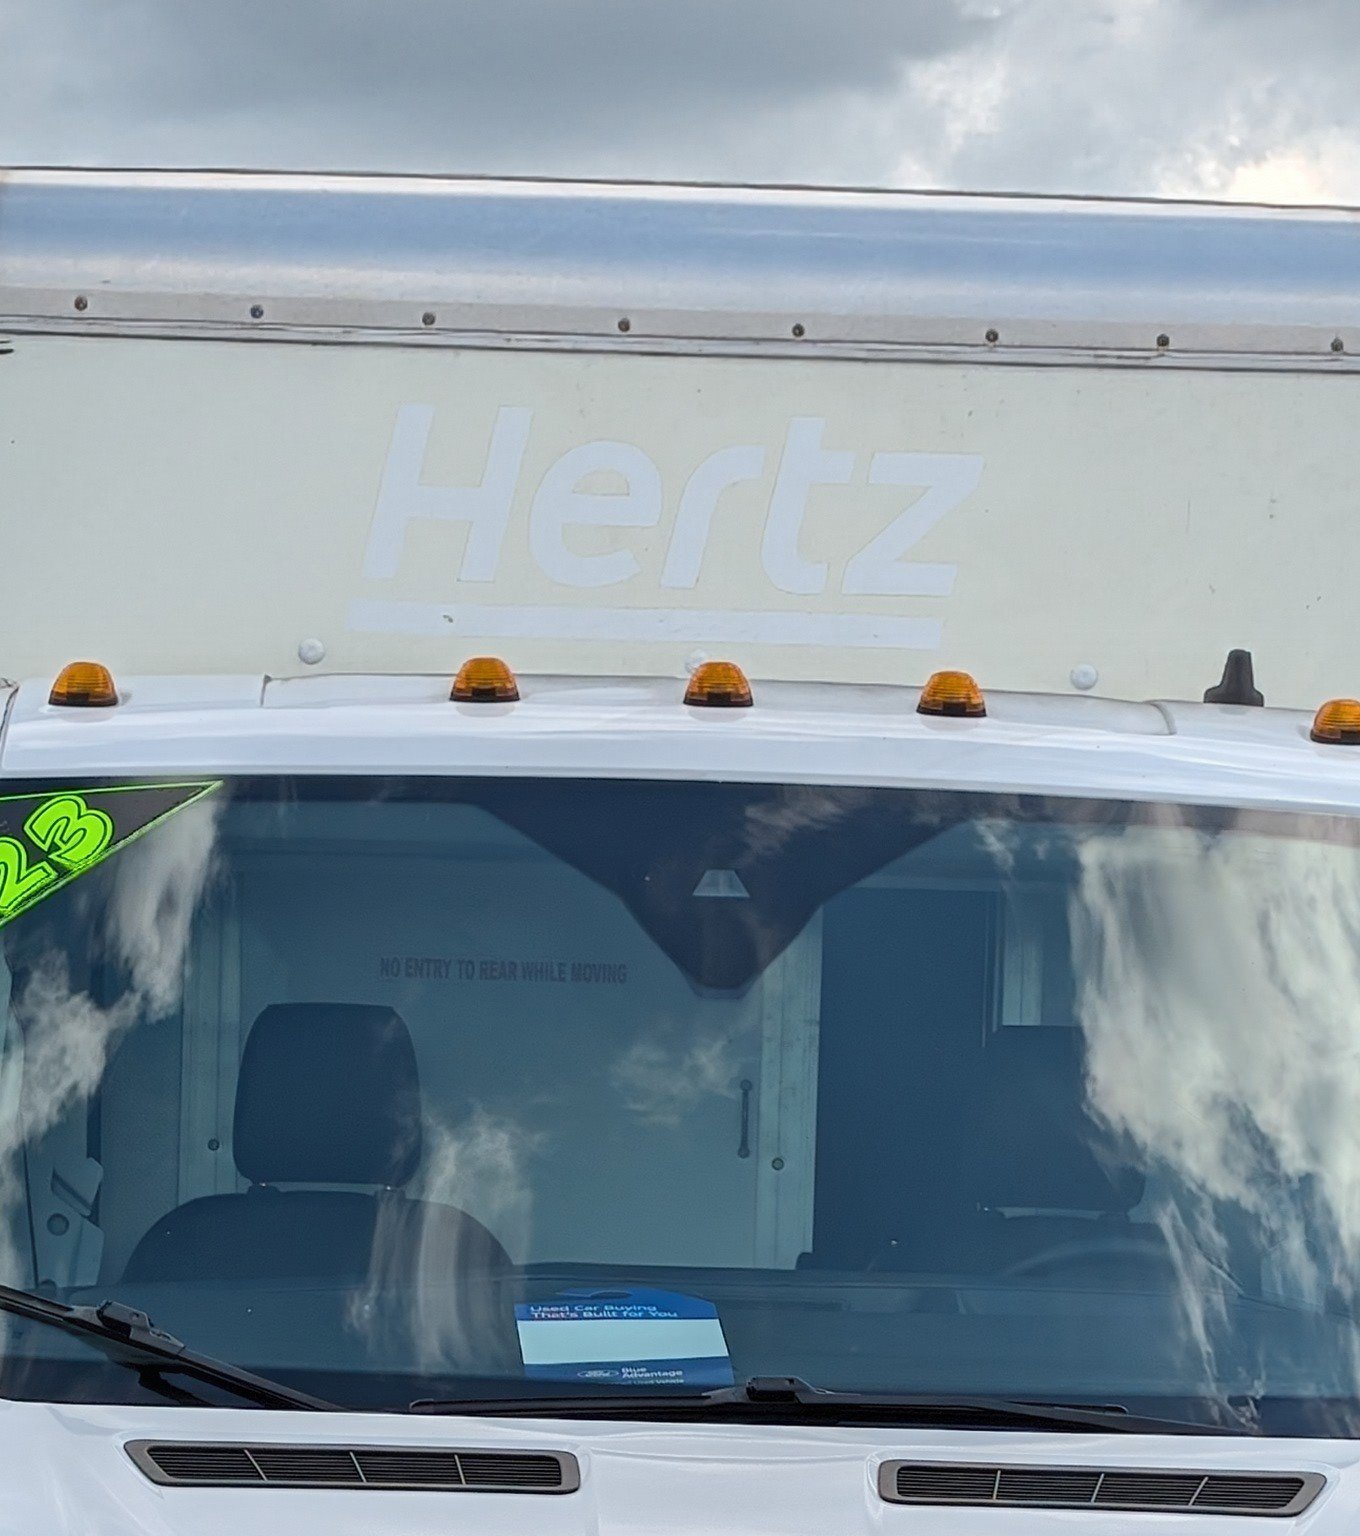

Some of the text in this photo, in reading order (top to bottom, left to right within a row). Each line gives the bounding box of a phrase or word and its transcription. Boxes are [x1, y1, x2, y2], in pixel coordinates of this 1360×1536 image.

[360, 403, 984, 597] Hertz
[380, 957, 628, 984] NO ENTRY TO REAR WHILE MOVING
[604, 1304, 658, 1312] Buying
[621, 1370, 684, 1378] Advantage
